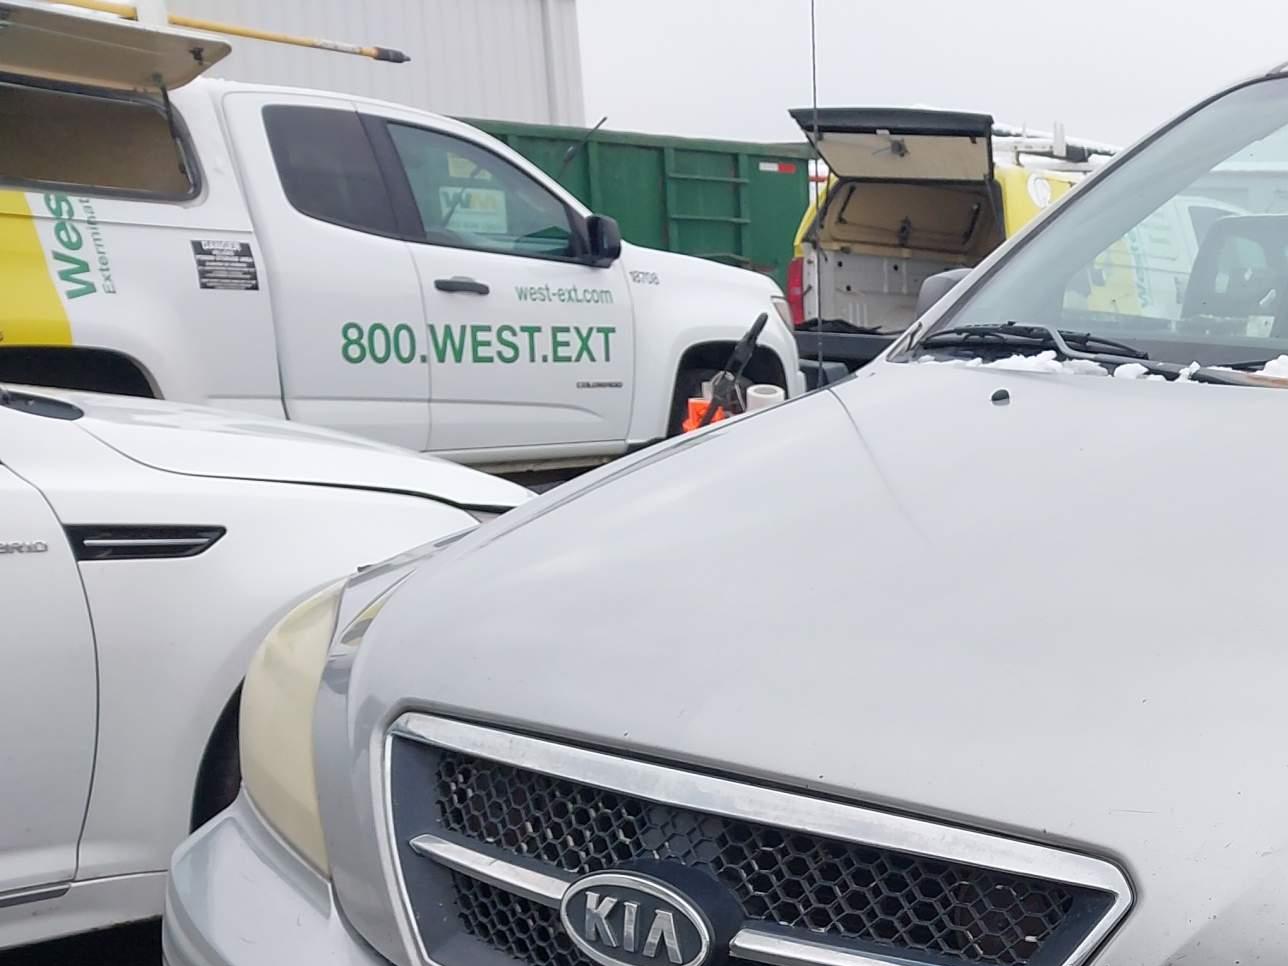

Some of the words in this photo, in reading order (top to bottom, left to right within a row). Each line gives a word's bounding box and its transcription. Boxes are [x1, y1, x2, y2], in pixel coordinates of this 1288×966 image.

[515, 284, 613, 304] west-ext.com
[341, 321, 616, 364] 800.WEST.EXT
[584, 891, 683, 964] KIA
